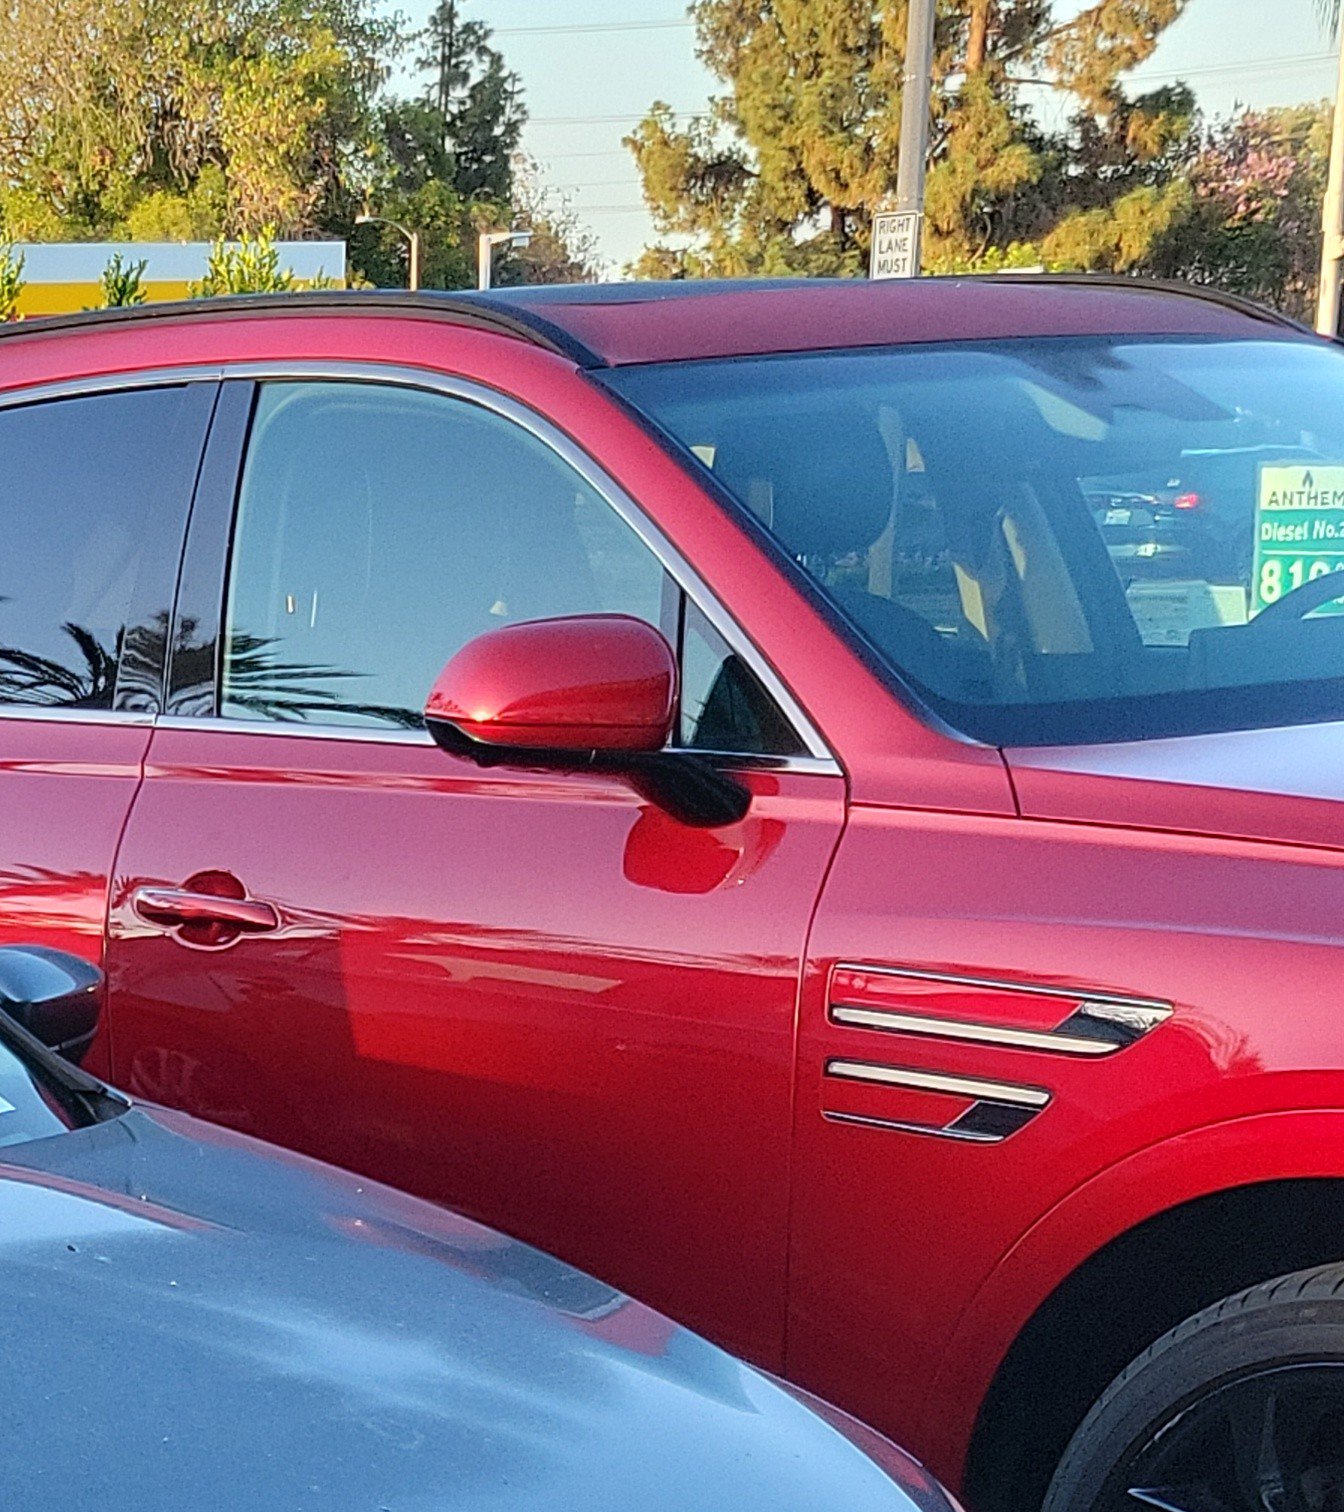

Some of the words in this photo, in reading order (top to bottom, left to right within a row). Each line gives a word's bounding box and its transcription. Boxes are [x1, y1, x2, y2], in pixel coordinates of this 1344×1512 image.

[878, 217, 911, 235] RIGHT
[878, 237, 909, 255] LANE
[877, 257, 907, 275] MUST
[1261, 519, 1308, 542] Diesel
